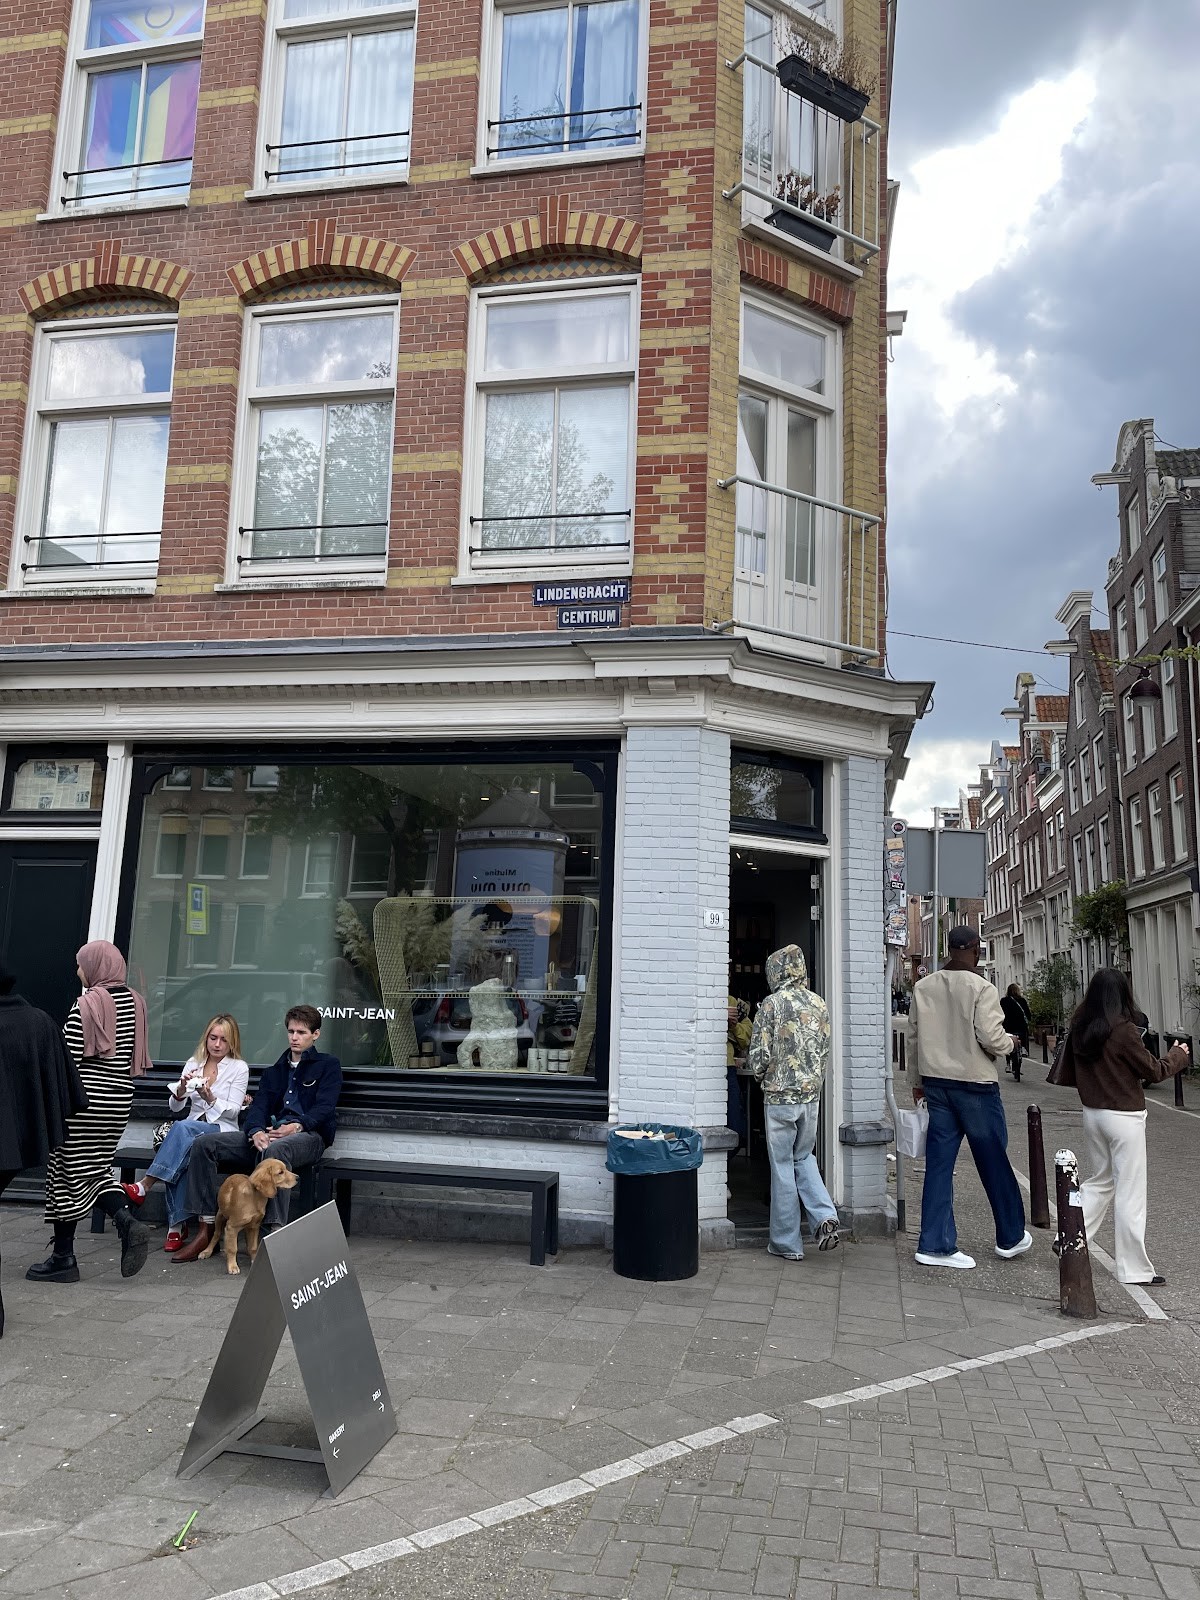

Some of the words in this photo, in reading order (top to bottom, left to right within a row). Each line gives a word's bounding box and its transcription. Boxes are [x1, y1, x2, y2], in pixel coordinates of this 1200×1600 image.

[536, 584, 626, 602] LINDENGRACHT
[562, 609, 616, 624] CENTRUM
[709, 912, 720, 925] 99
[316, 1006, 395, 1020] SAINT-JEAN
[291, 1260, 348, 1310] SAINT-JEAN
[372, 1388, 382, 1401] DELI
[328, 1423, 345, 1444] BAKERY
